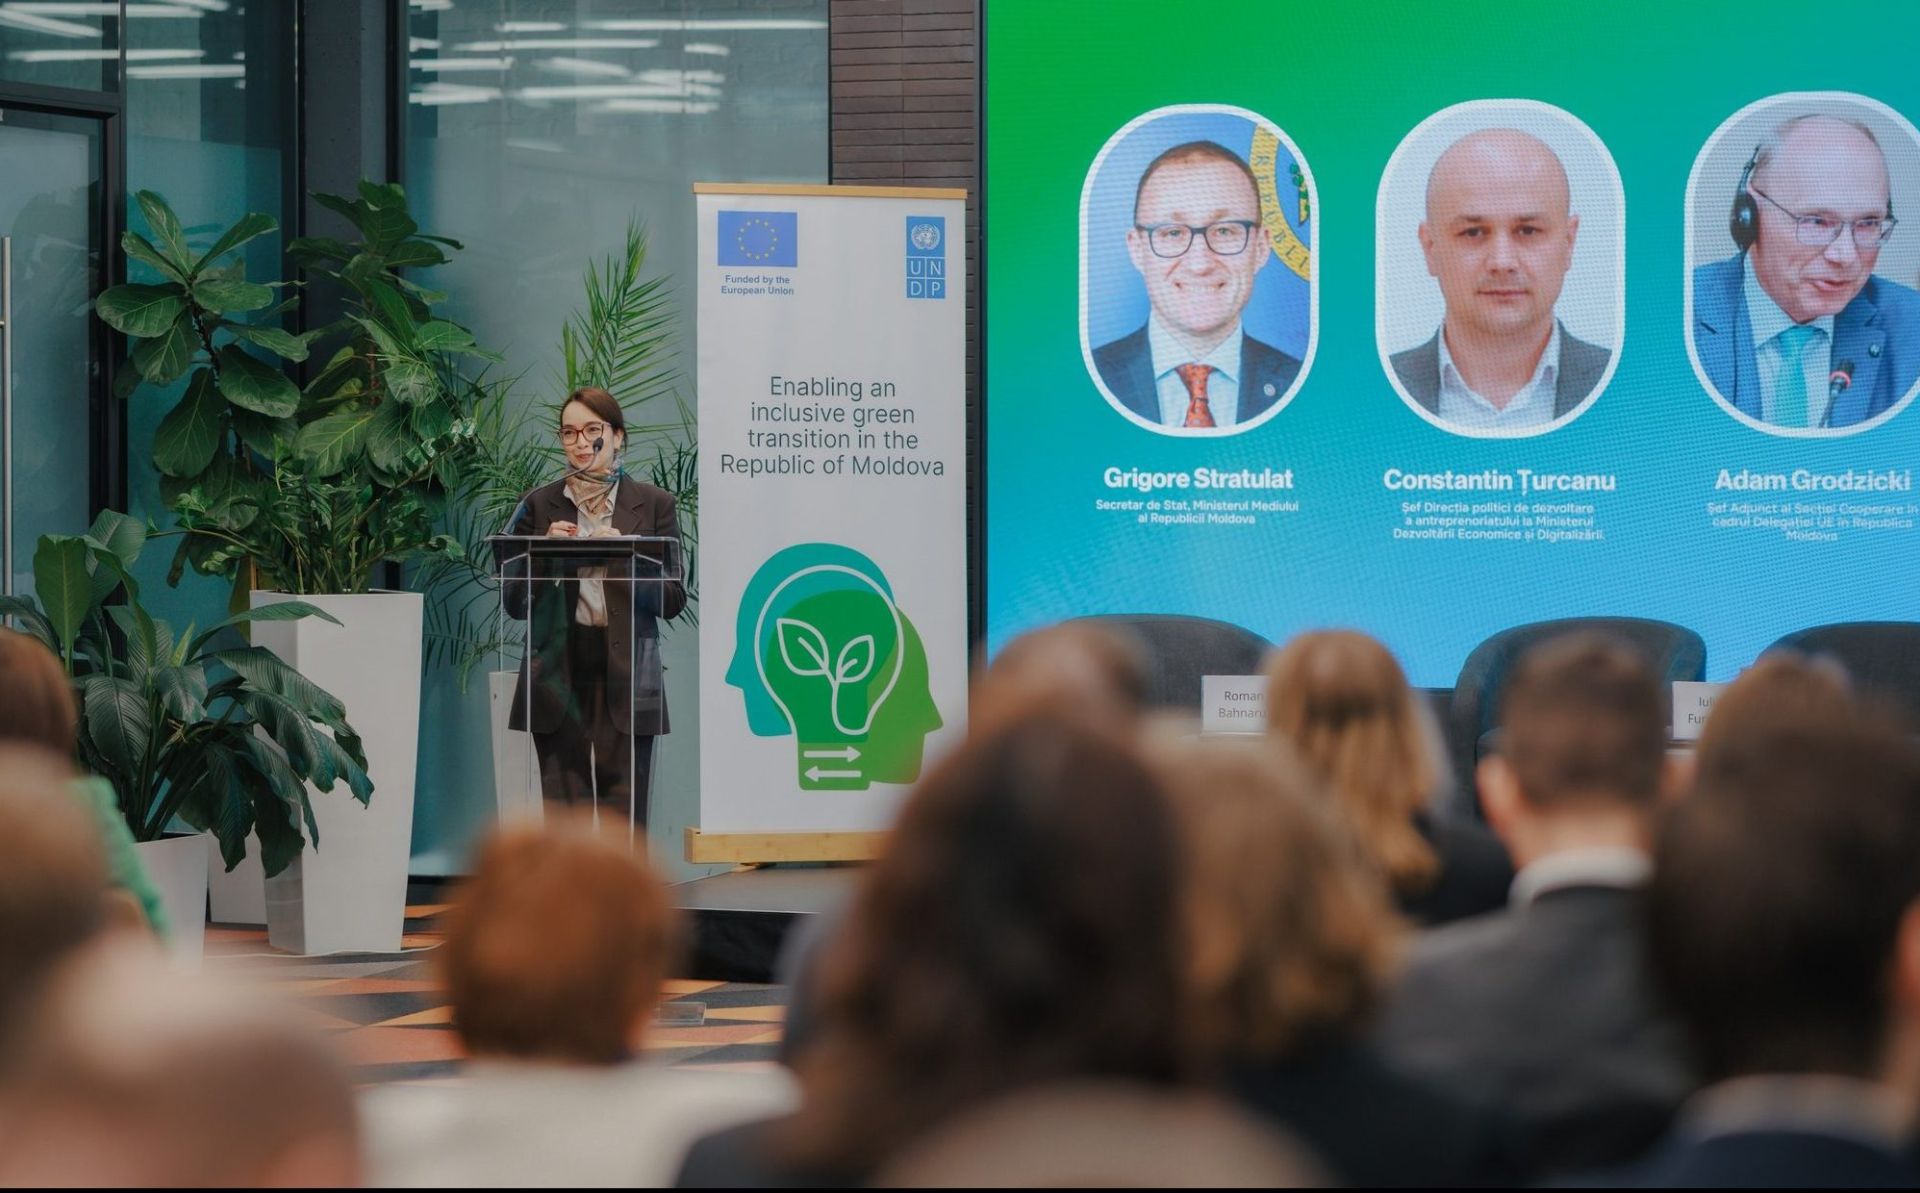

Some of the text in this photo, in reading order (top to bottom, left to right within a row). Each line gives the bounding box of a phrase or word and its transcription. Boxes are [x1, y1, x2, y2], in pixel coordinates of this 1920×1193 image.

[725, 274, 791, 286] Funded by the
[720, 285, 795, 296] European Union
[770, 376, 896, 402] Enabling an
[751, 401, 915, 428] inclusive green
[748, 428, 919, 450] transition in the
[721, 454, 944, 479] Republic of Moldova
[1103, 467, 1294, 492] Grigore Stratulat
[1383, 468, 1616, 496] Constantin Țurcanu
[1715, 468, 1912, 491] Adam Grodzicki
[1095, 499, 1299, 512] Secretar de Stat, Ministerul Mediului
[1472, 502, 1511, 515] politici
[1514, 503, 1529, 513] de
[1532, 503, 1595, 514] dezvoltare
[1731, 503, 1778, 516] Adjunct
[1839, 503, 1904, 516] Cooperare
[1138, 512, 1256, 526] al Republicii Moldova
[1405, 515, 1594, 528] a antreprenoriatului la Ministerul
[1711, 517, 1751, 528] cadrul
[1852, 518, 1913, 530] Republica
[1457, 528, 1522, 540] Economice
[1786, 531, 1838, 541] Moldova
[1224, 691, 1264, 702] Roman
